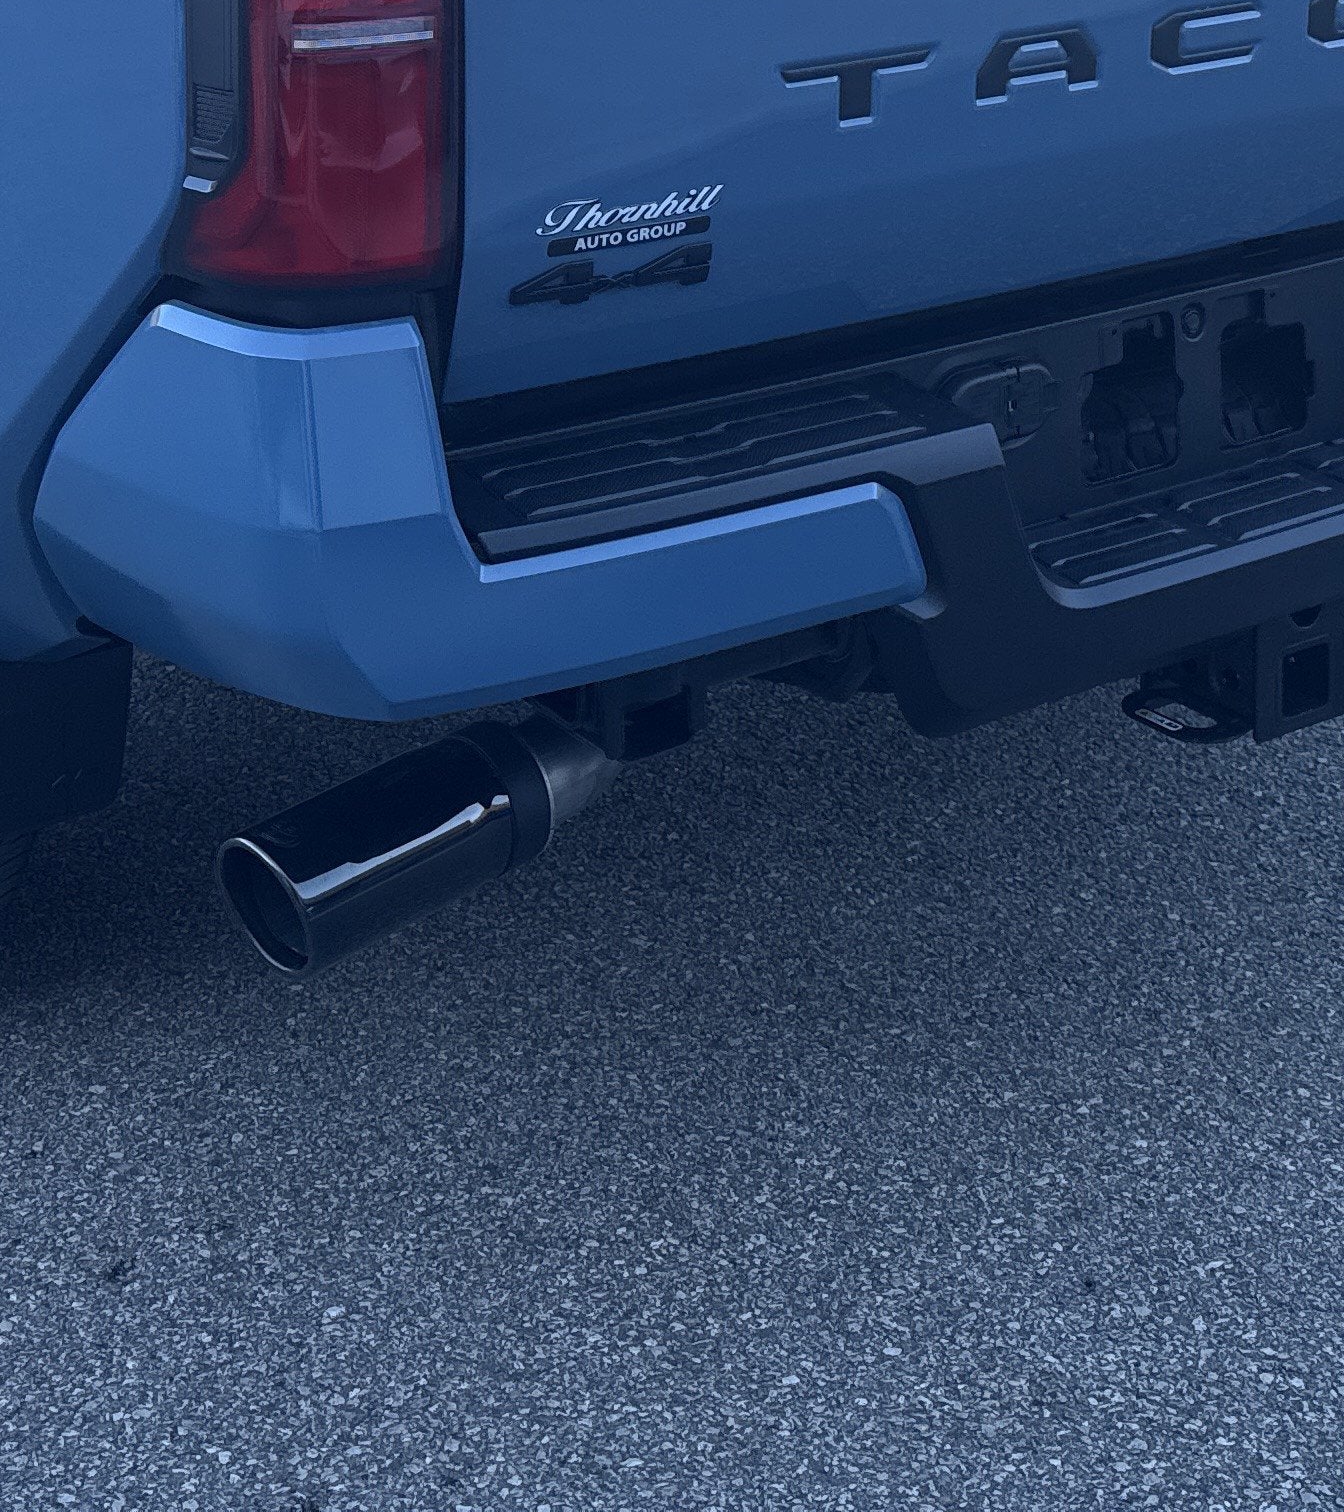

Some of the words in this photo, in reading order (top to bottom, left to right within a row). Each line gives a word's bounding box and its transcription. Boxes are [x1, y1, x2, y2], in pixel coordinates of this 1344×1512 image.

[535, 184, 725, 237] Thornhill
[574, 233, 622, 252] AUTO
[626, 221, 687, 244] GROUP
